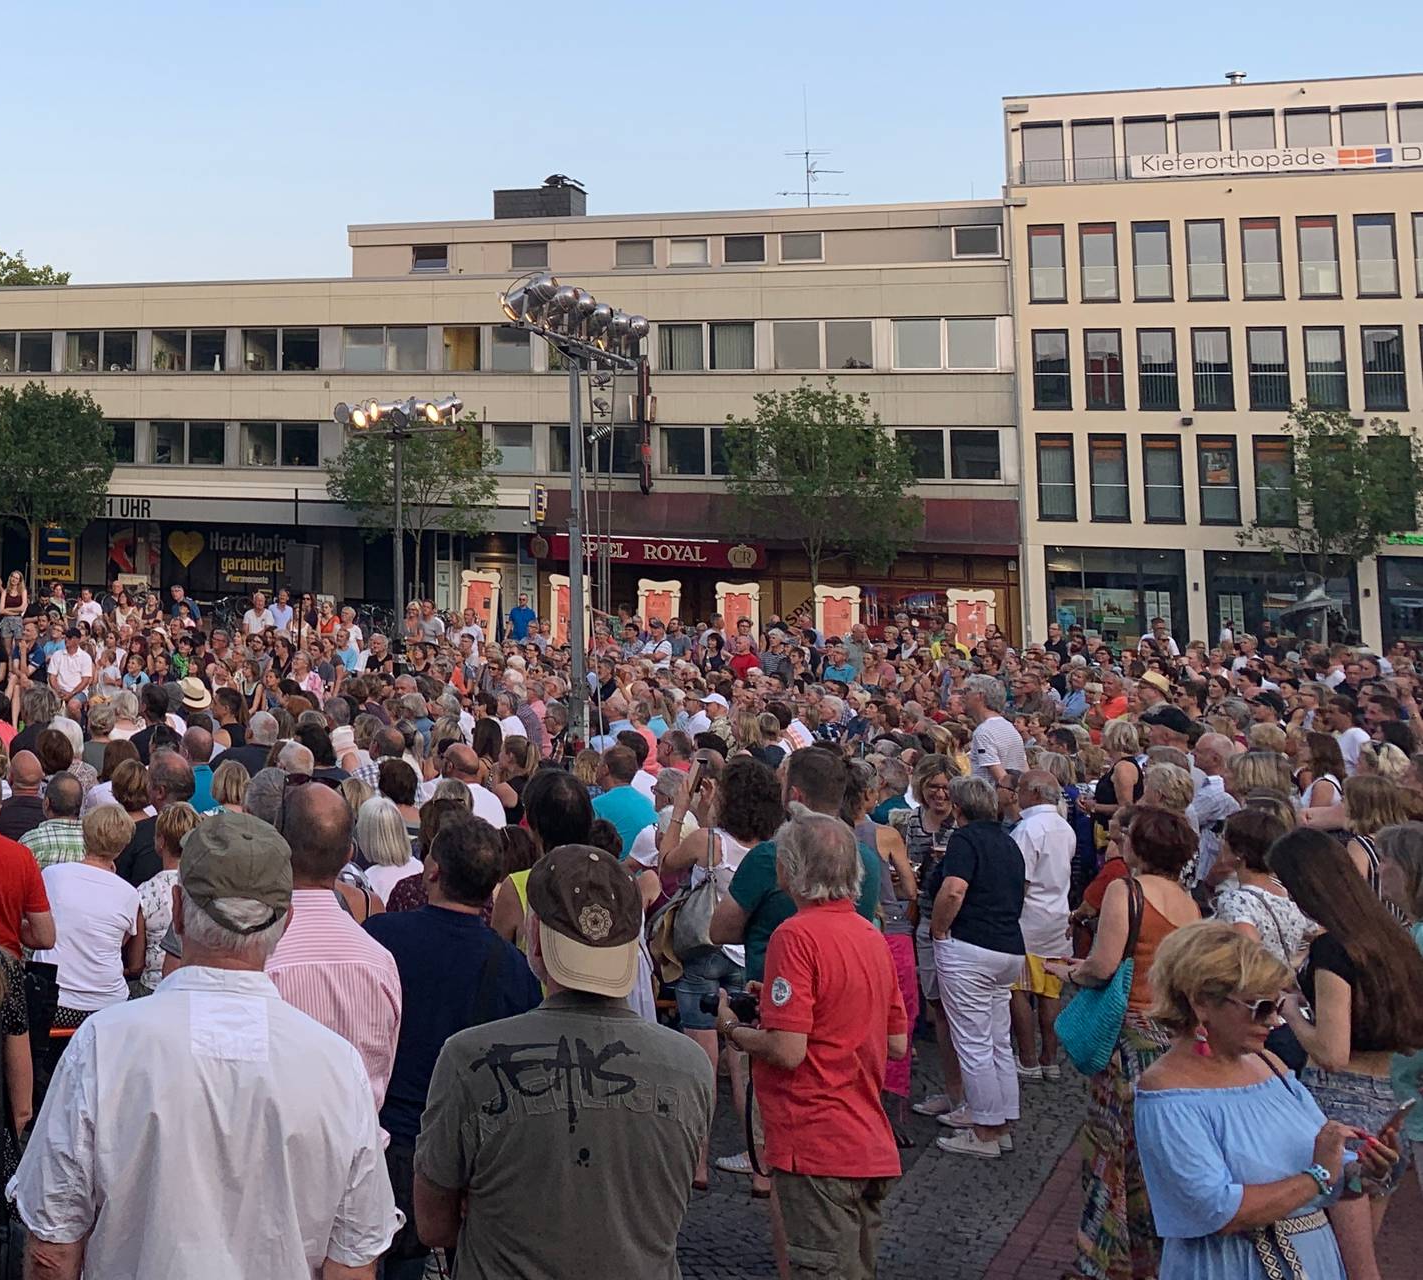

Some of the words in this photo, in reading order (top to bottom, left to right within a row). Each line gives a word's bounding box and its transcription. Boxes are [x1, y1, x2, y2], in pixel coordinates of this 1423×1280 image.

[1141, 147, 1326, 173] Kieferorthopäde
[120, 498, 151, 518] UHR
[209, 531, 297, 555] Herzklopfe
[643, 543, 708, 562] ROYAL
[37, 567, 72, 577] EDEKA
[220, 556, 285, 574] garantiert!
